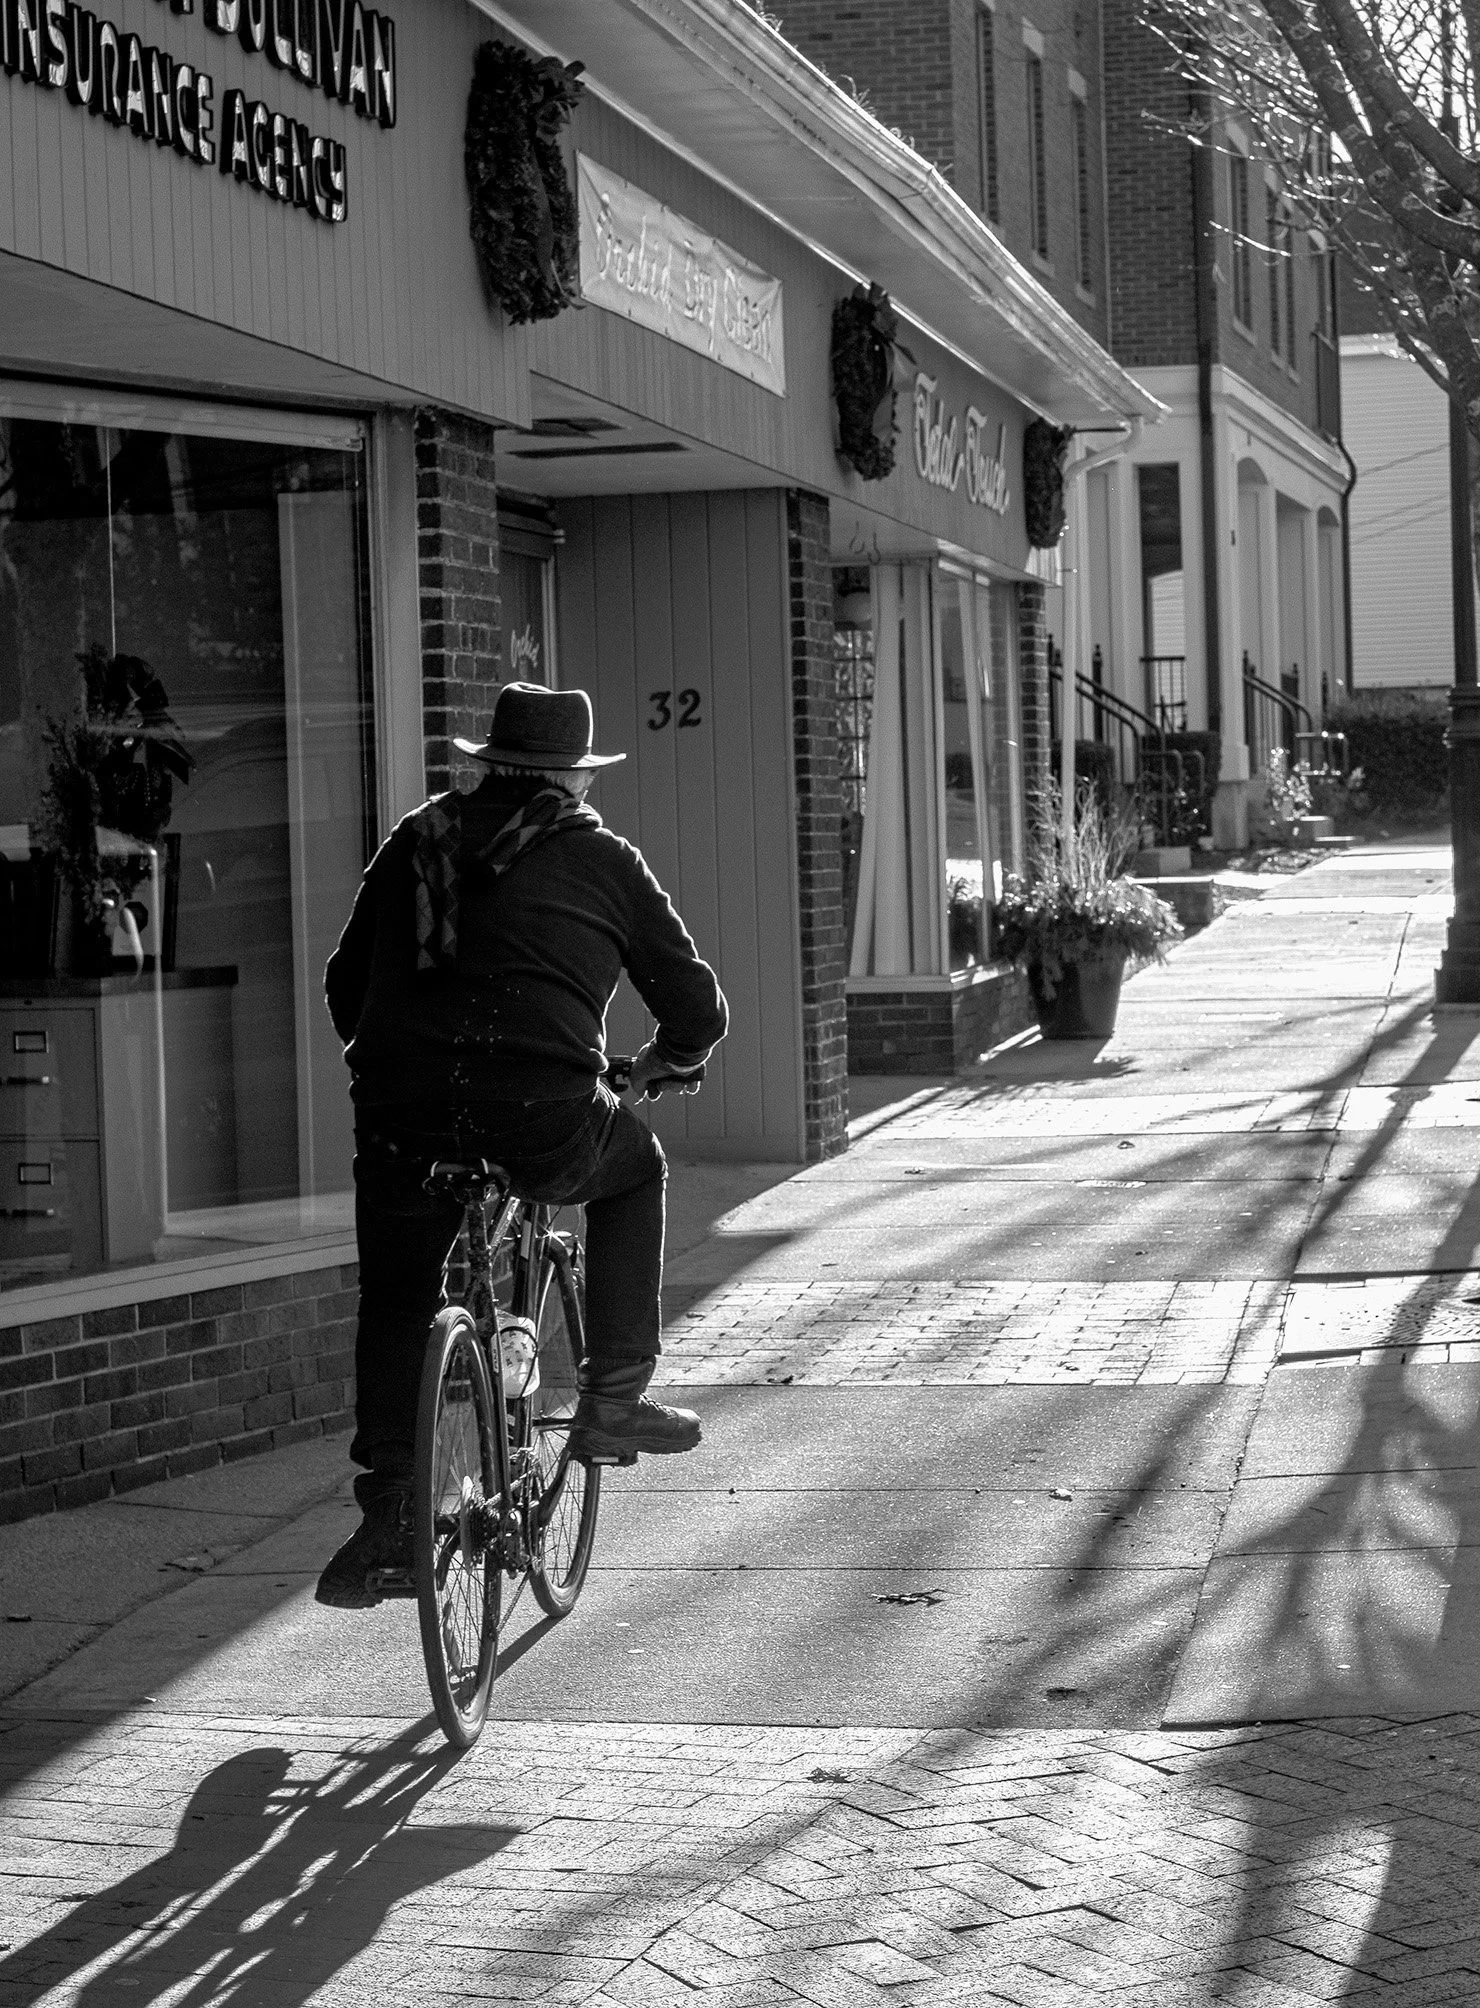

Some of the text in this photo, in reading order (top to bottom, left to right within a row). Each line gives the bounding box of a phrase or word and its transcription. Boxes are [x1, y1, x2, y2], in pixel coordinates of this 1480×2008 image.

[0, 0, 348, 222] INSURANCE AGENCY
[647, 688, 702, 732] 32
